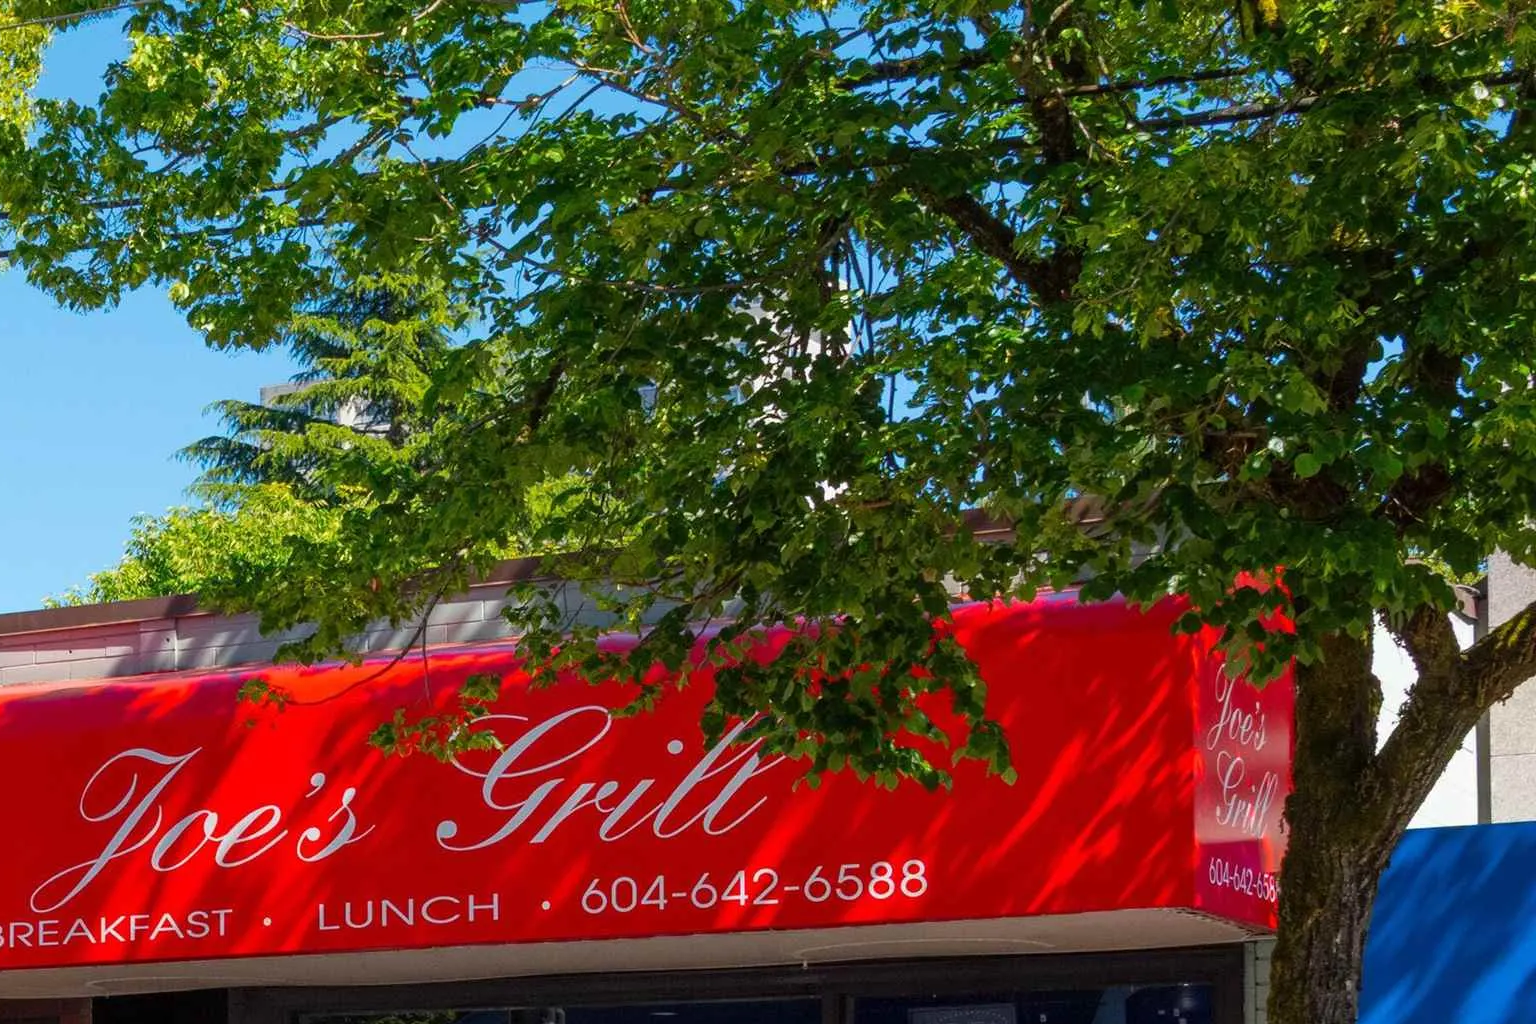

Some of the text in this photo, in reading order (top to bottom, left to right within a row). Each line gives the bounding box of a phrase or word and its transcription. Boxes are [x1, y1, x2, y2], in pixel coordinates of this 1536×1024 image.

[1206, 663, 1267, 751] Joe's
[30, 704, 789, 913] Joe's Grill
[1216, 750, 1279, 840] Grill
[318, 893, 501, 932] LUNCH
[581, 858, 929, 914] 604-642-6588
